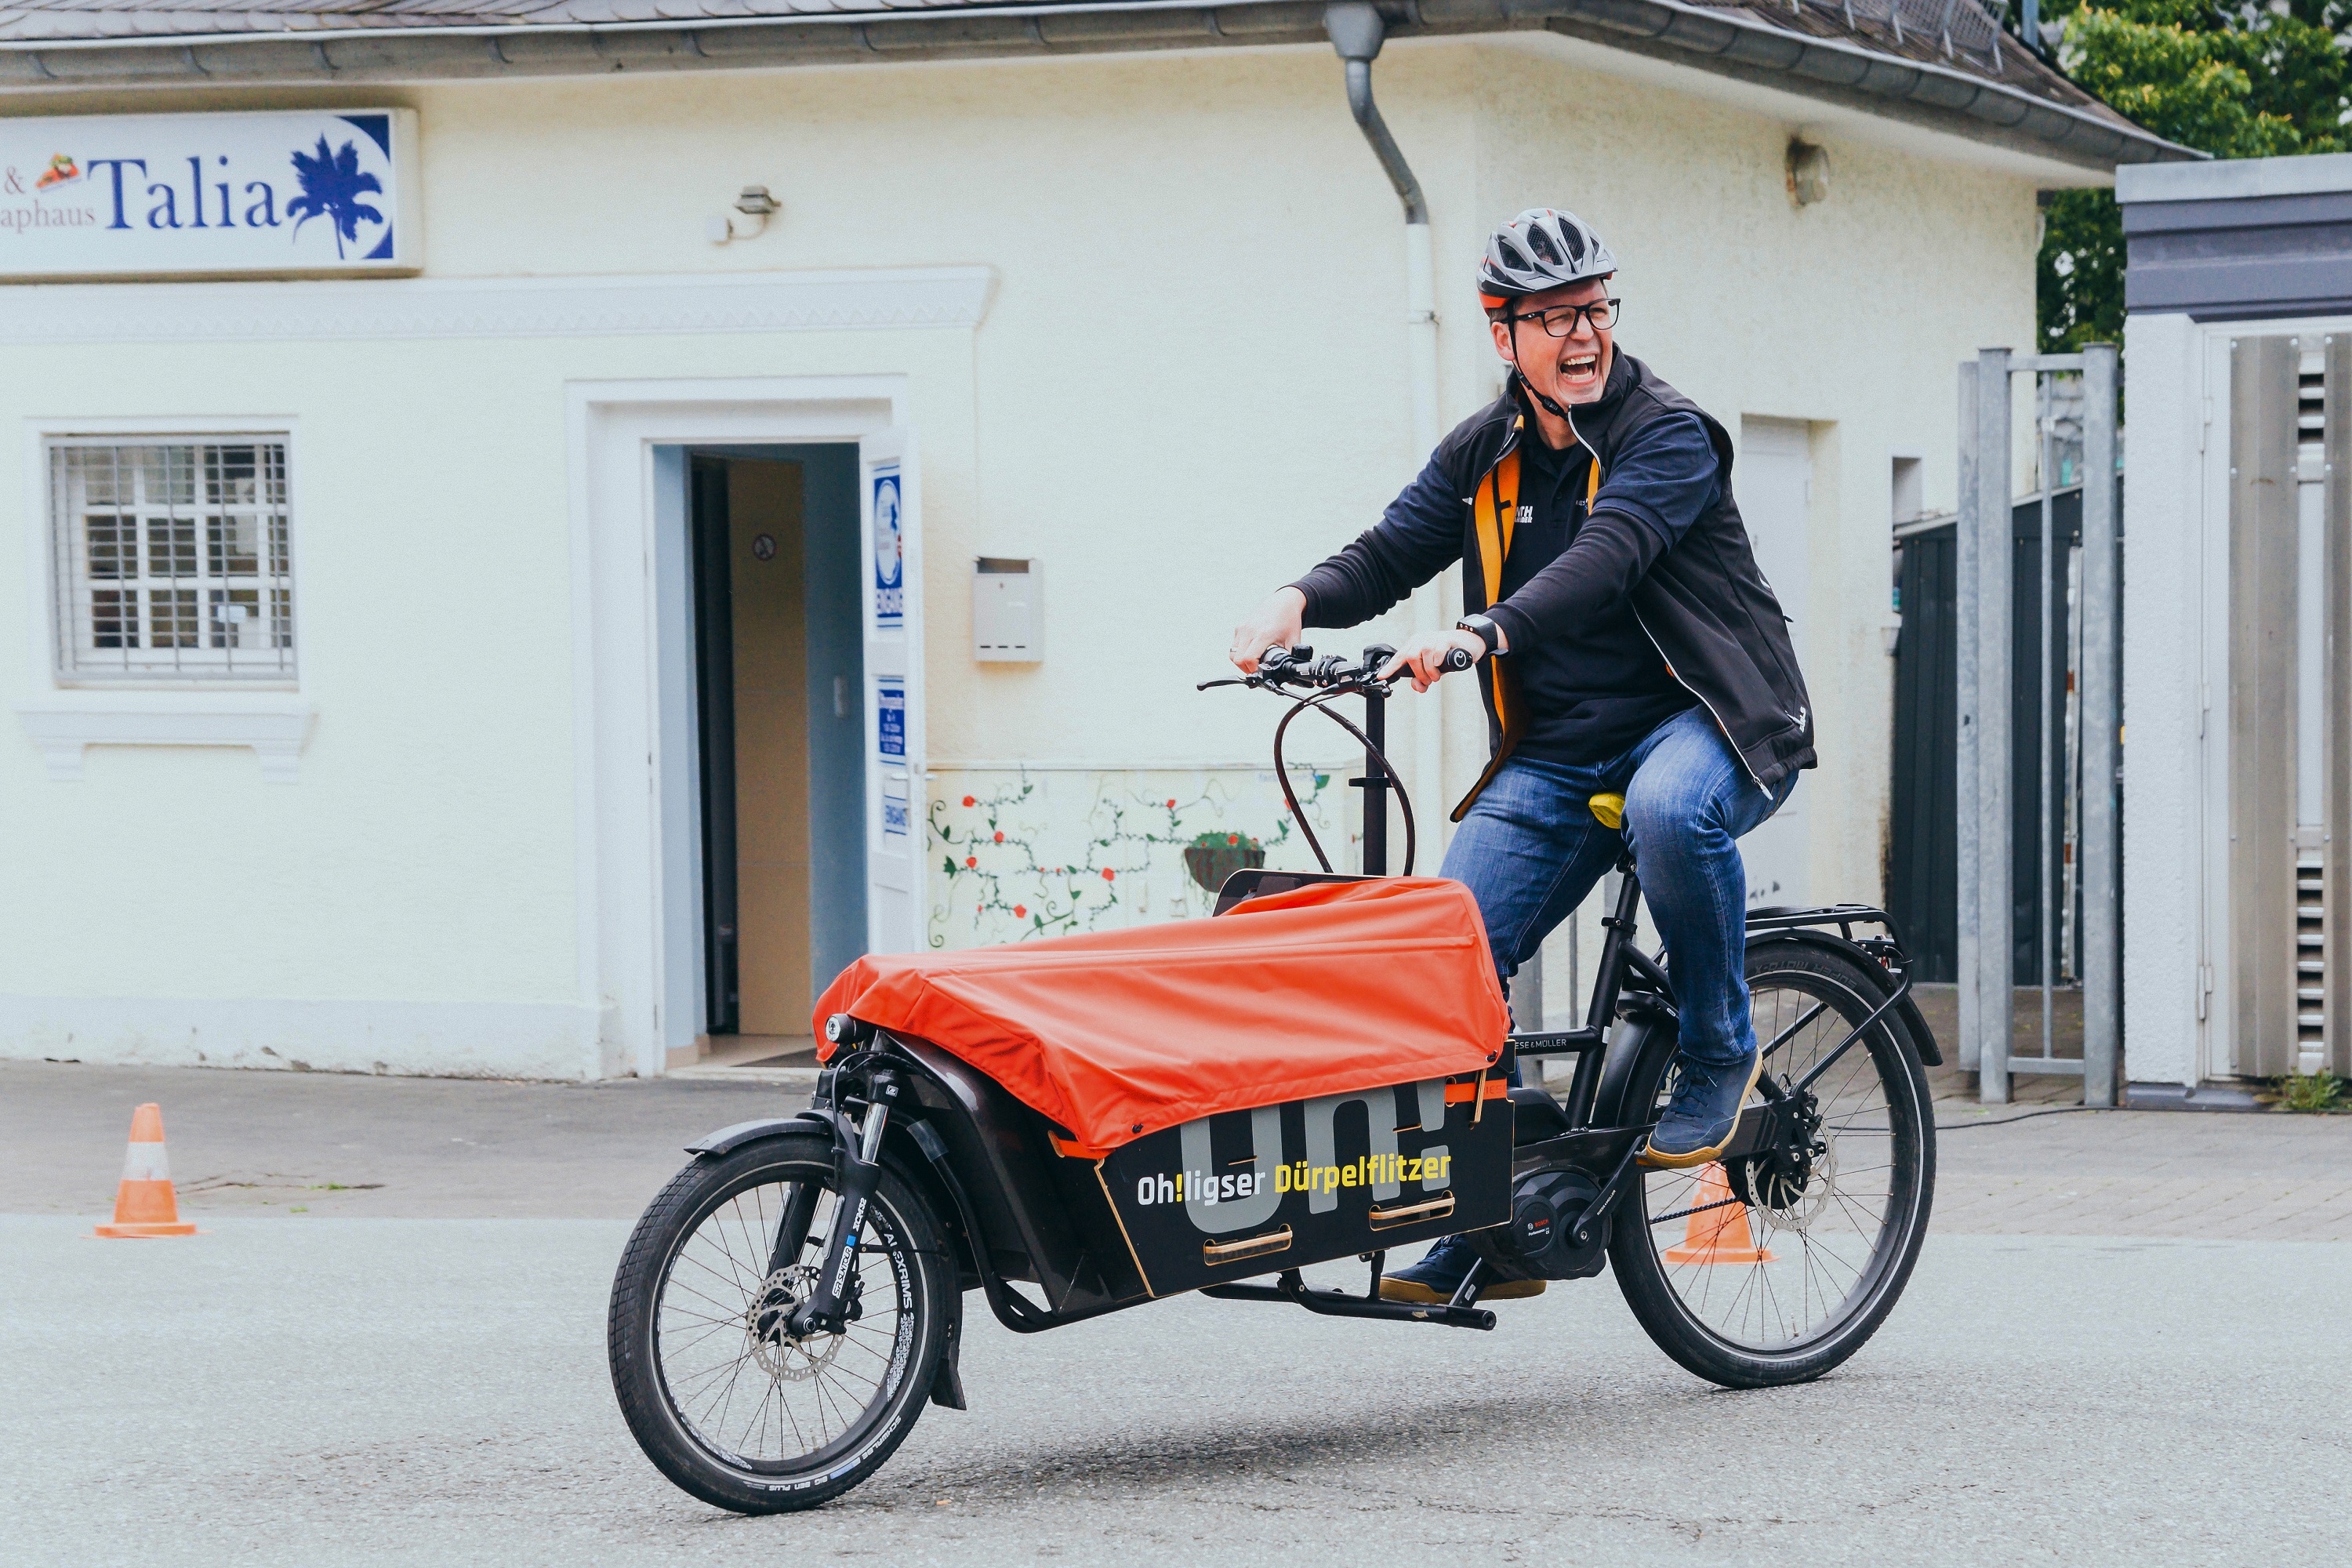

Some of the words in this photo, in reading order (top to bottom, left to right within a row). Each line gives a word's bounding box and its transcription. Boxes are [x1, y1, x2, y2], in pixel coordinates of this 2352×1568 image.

[86, 155, 281, 229] Talia
[1535, 1039, 1566, 1047] MÜLLER
[1138, 1170, 1266, 1207] Oh!ligser
[1275, 1152, 1451, 1195] Dürpelflitzer
[837, 1247, 852, 1281] SUNTOUR
[862, 1414, 902, 1460] SCHWALBE
